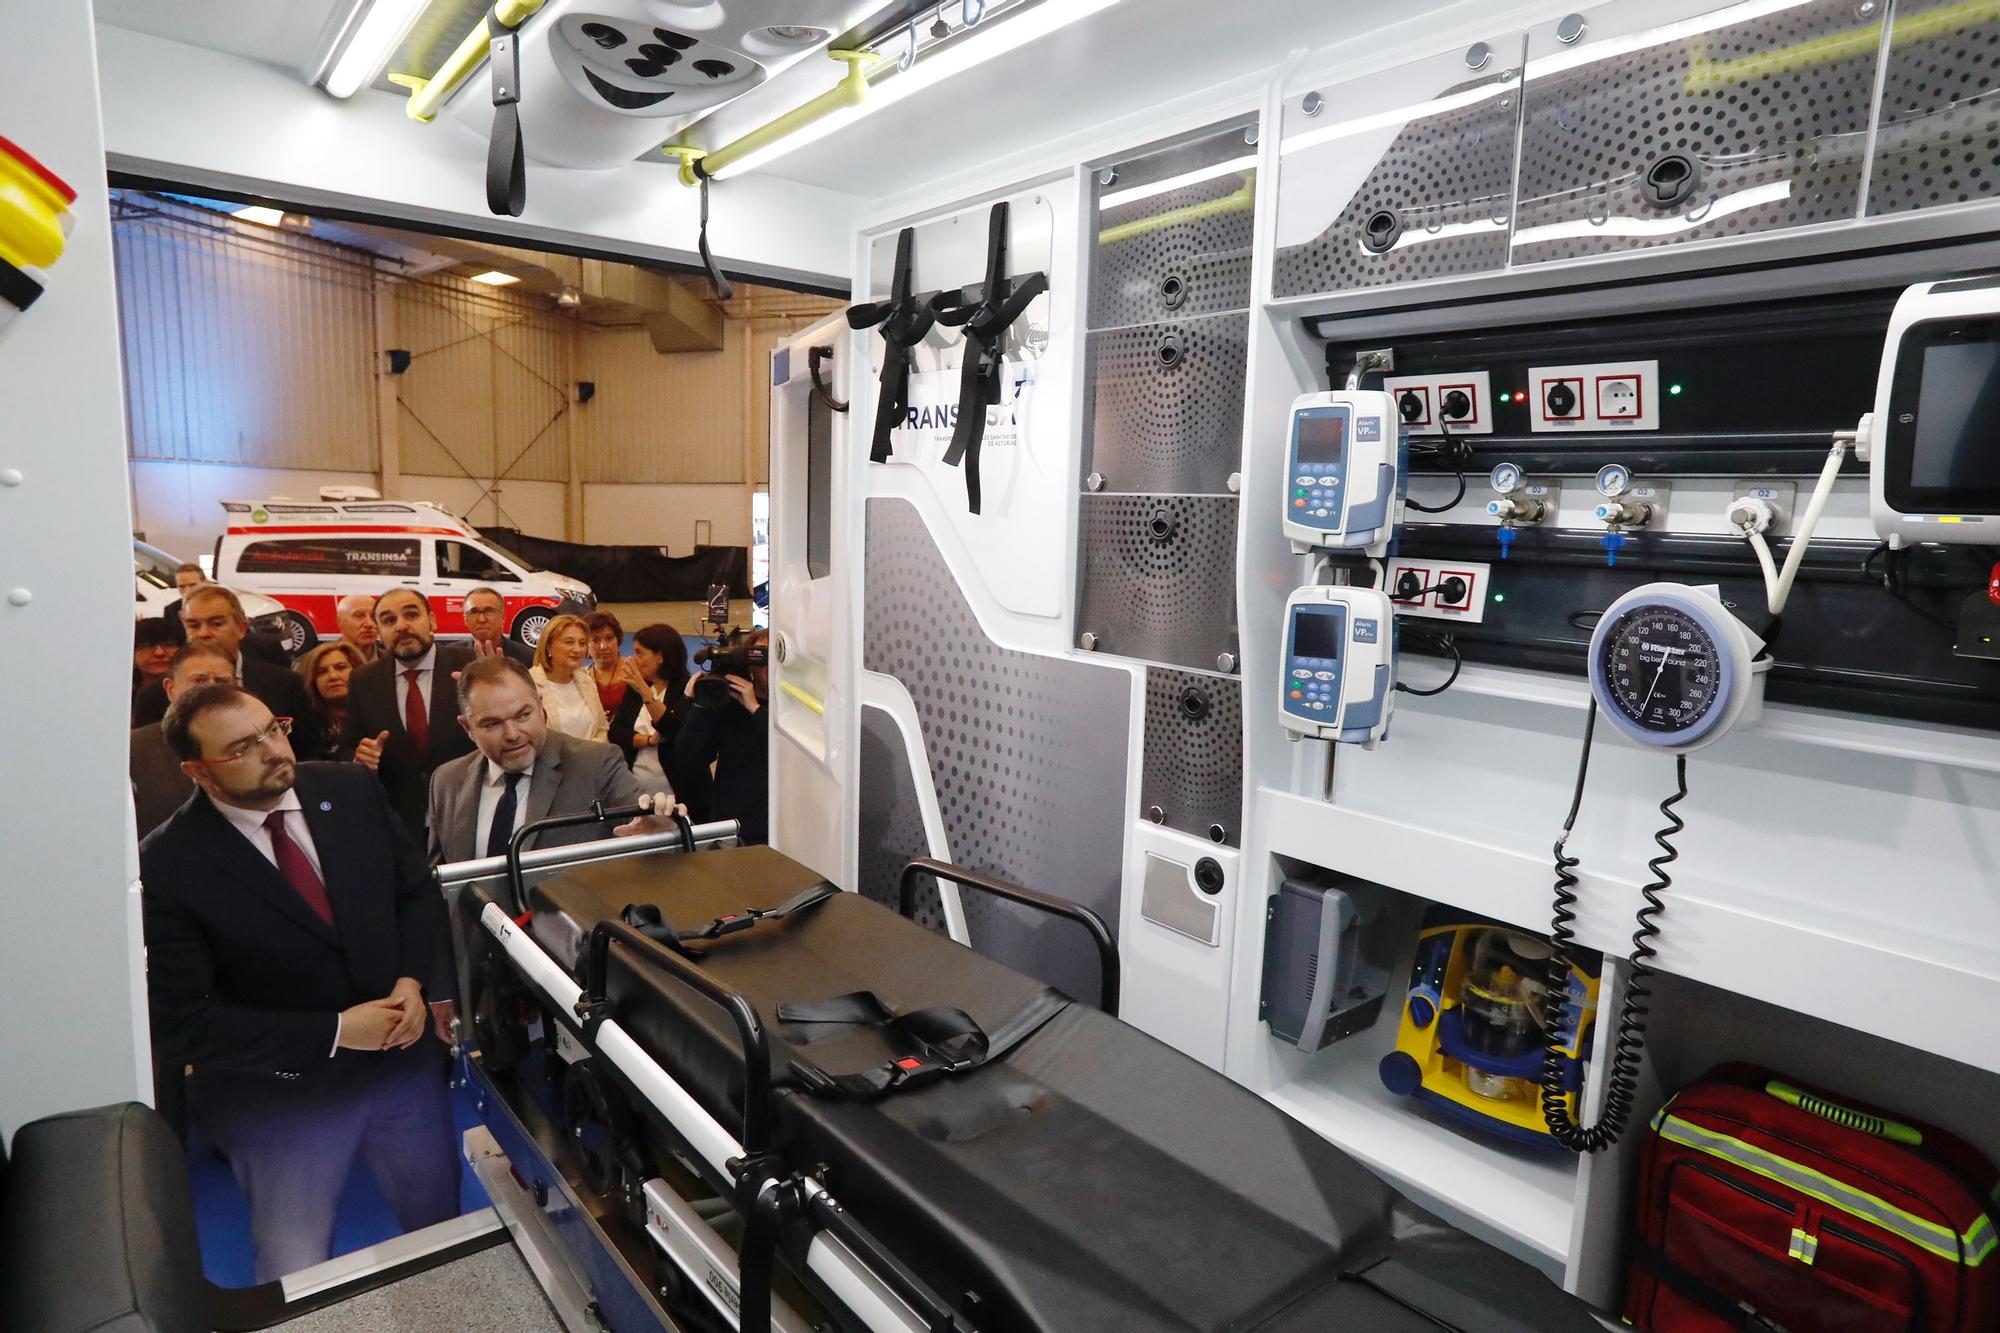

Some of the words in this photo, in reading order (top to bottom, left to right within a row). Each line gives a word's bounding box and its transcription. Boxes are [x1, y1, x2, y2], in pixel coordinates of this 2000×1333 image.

[1357, 427, 1369, 435] VP
[345, 552, 407, 561] TRANSINSA
[1652, 622, 1663, 630] 140
[1667, 624, 1678, 632] 160
[1354, 628, 1366, 636] VP
[1638, 627, 1649, 635] 120
[1628, 636, 1639, 644] 100
[1680, 632, 1691, 640] 180
[1620, 648, 1629, 656] 80
[1650, 644, 1686, 655] Rieter
[1688, 644, 1701, 652] 200
[1640, 654, 1650, 663] big
[1666, 659, 1686, 667] ound
[1694, 659, 1707, 667] 220
[1618, 663, 1627, 671] 60
[1621, 678, 1629, 686] 40
[1695, 675, 1708, 684] 240
[1629, 692, 1637, 700] 20
[1689, 689, 1702, 698] 260
[1680, 700, 1693, 709] 280
[1668, 708, 1681, 716] 300
